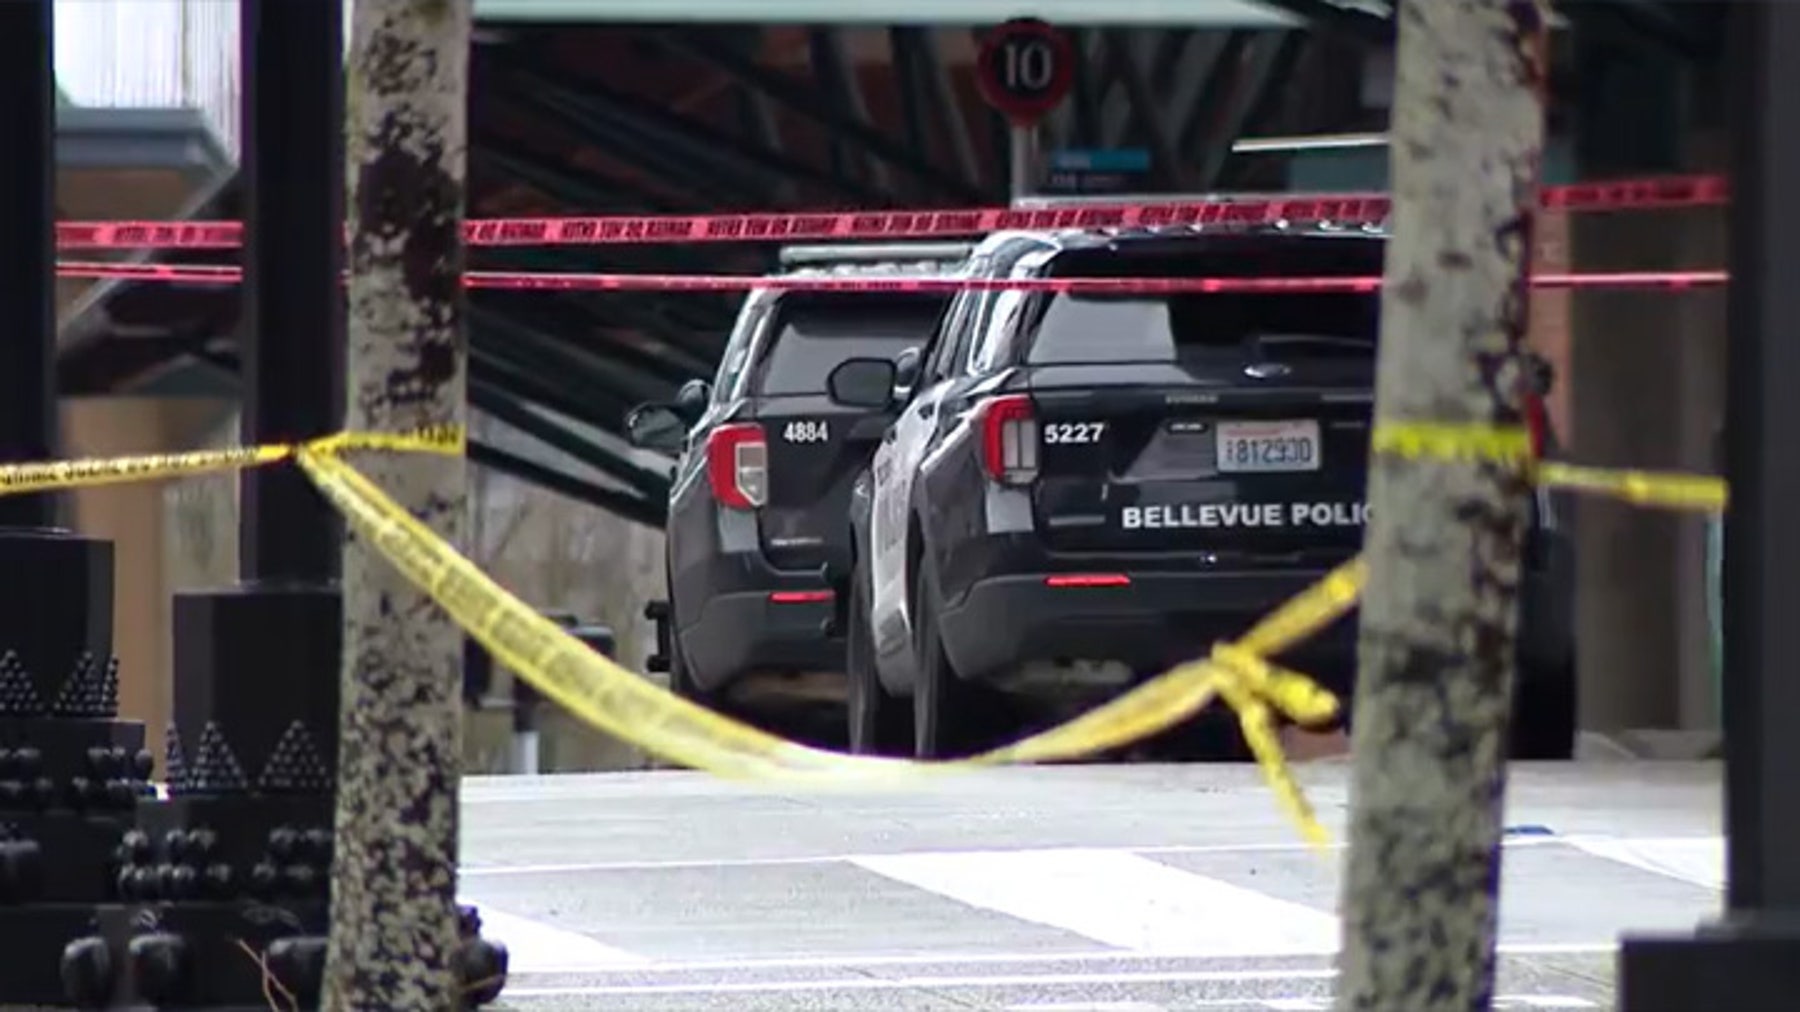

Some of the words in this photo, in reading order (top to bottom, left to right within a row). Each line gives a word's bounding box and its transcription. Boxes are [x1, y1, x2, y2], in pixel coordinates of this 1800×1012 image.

[1005, 42, 1052, 89] 10
[783, 420, 828, 443] 4884
[1044, 422, 1104, 444] 5227
[1122, 504, 1282, 529] BELLEVUE
